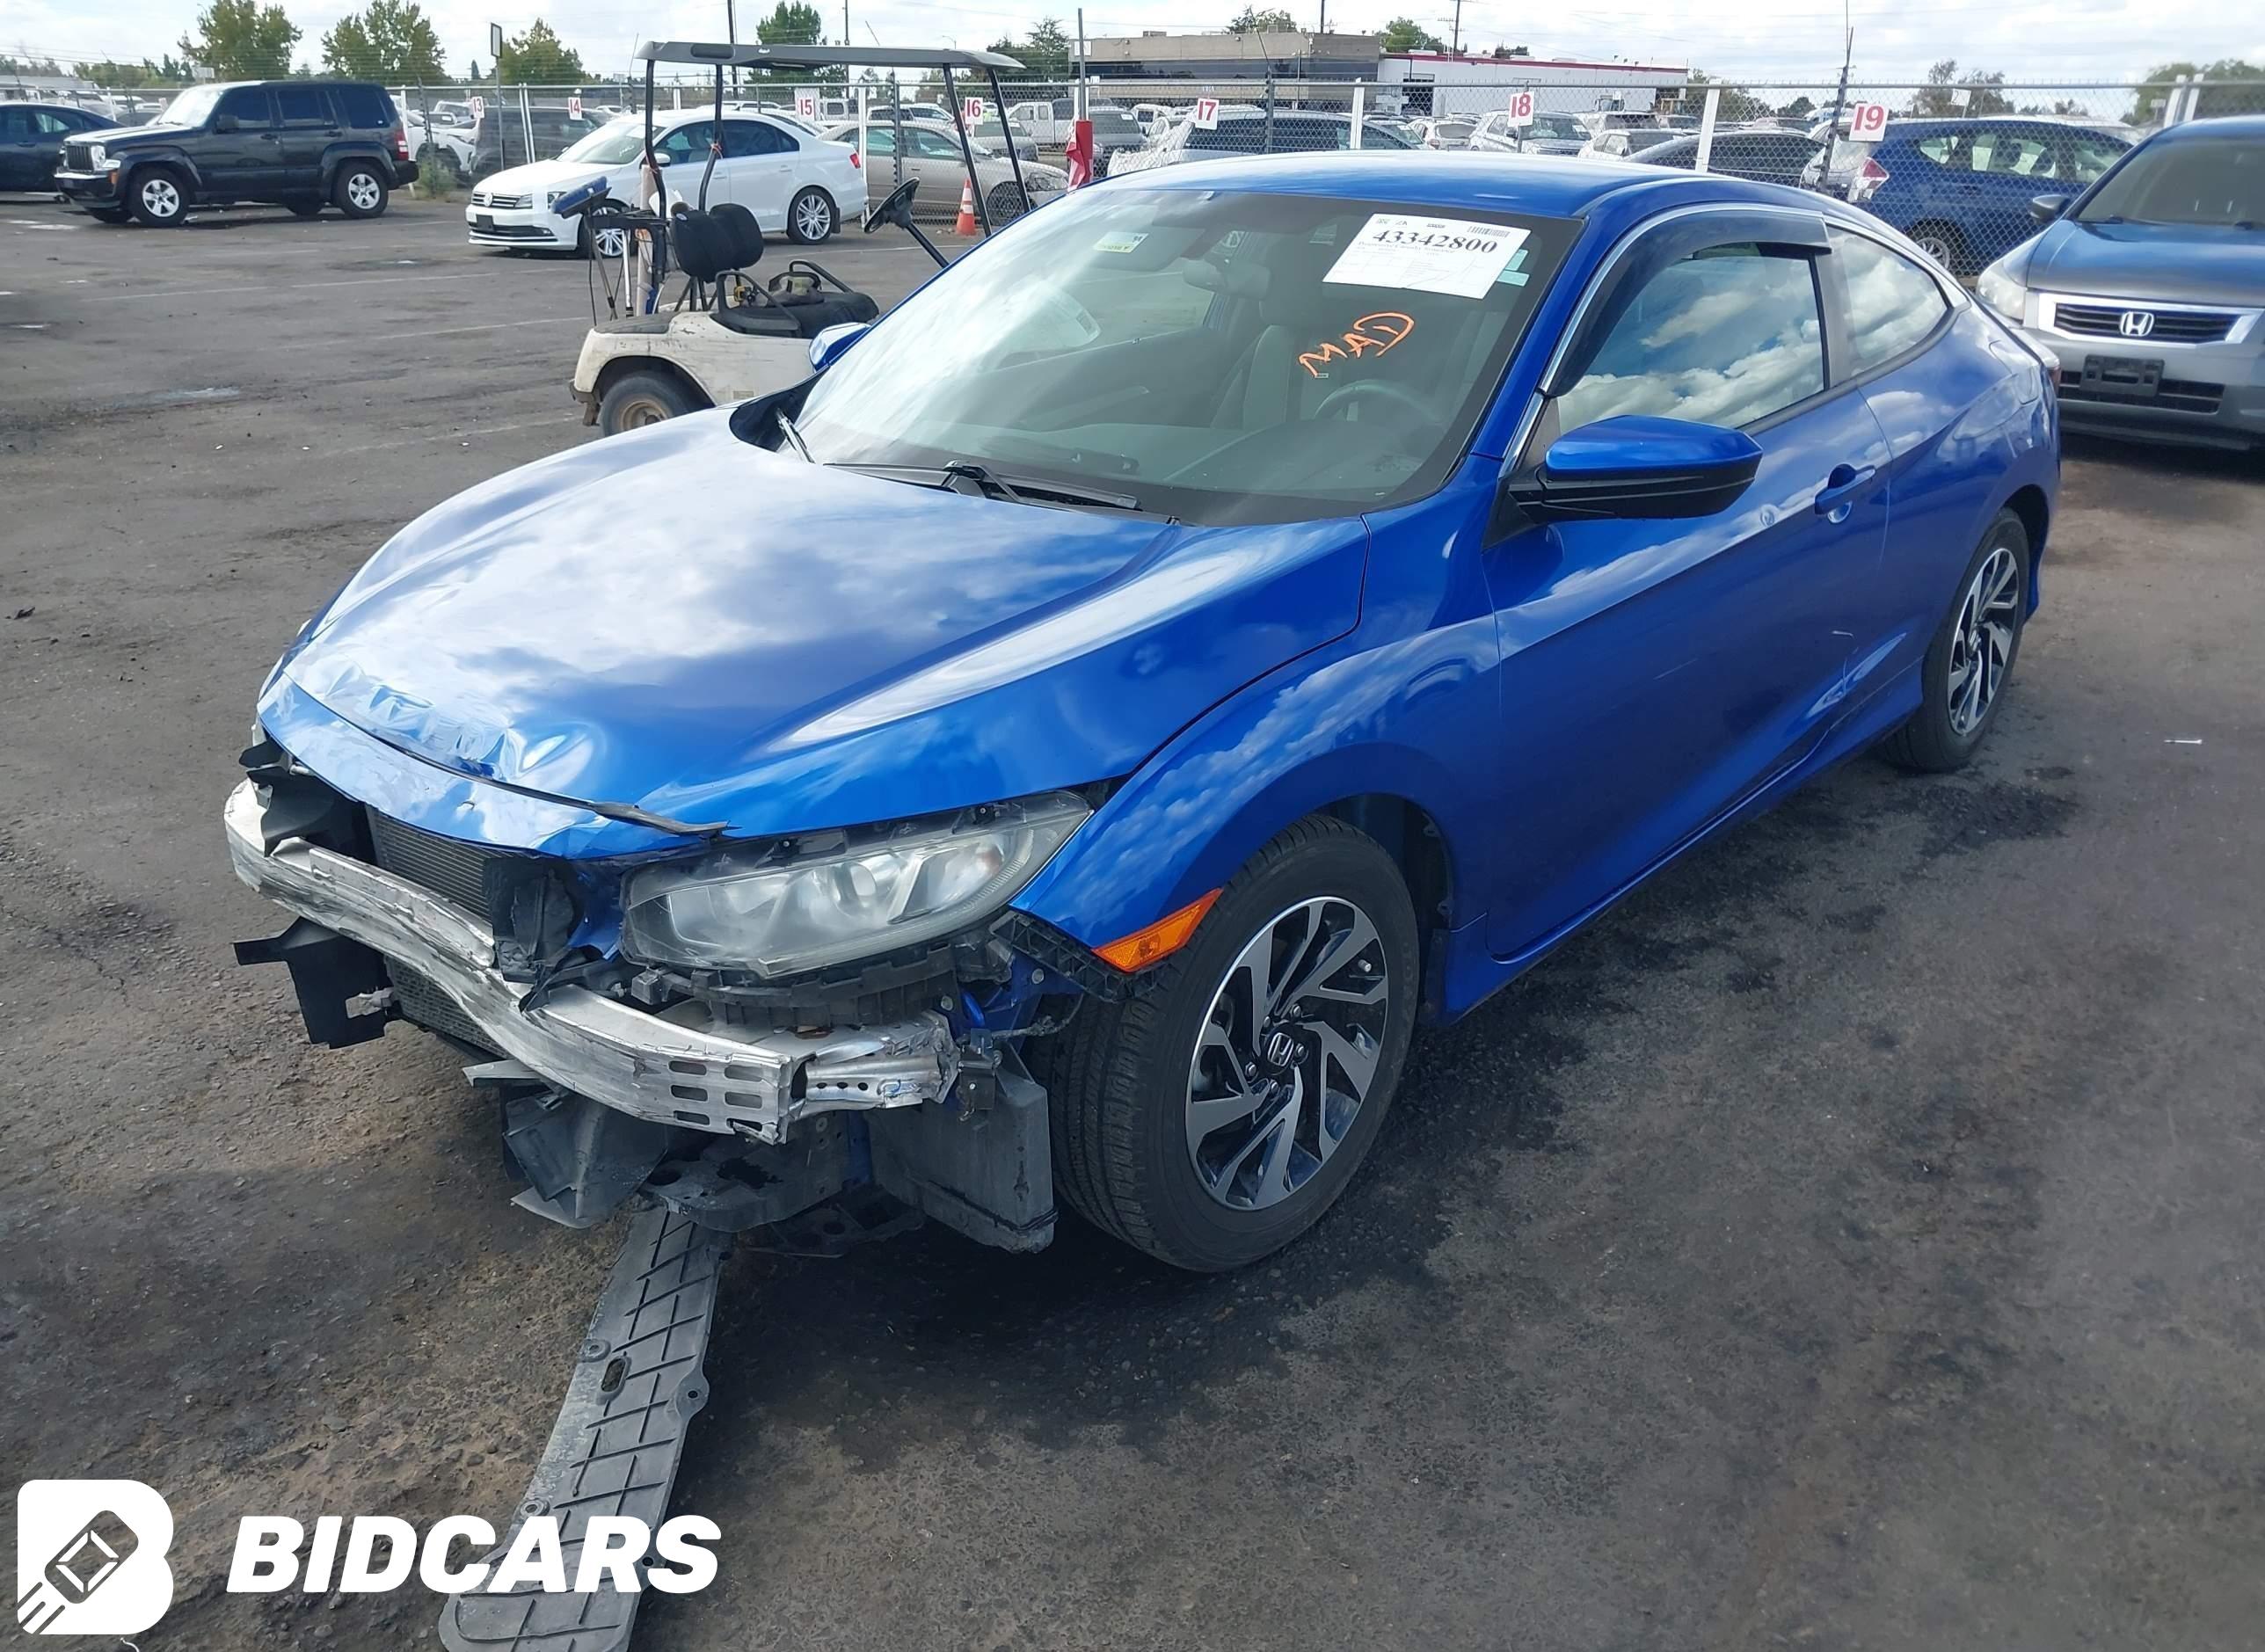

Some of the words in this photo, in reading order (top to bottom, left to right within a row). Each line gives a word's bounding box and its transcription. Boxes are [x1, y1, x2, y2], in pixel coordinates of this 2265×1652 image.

[473, 98, 483, 113] 13
[570, 98, 580, 113] 14
[800, 98, 812, 115] 15
[967, 98, 981, 118] 16
[1198, 100, 1217, 121] 17
[1511, 93, 1532, 119] 18
[1854, 106, 1884, 131] 19
[1372, 229, 1498, 254] 43342800
